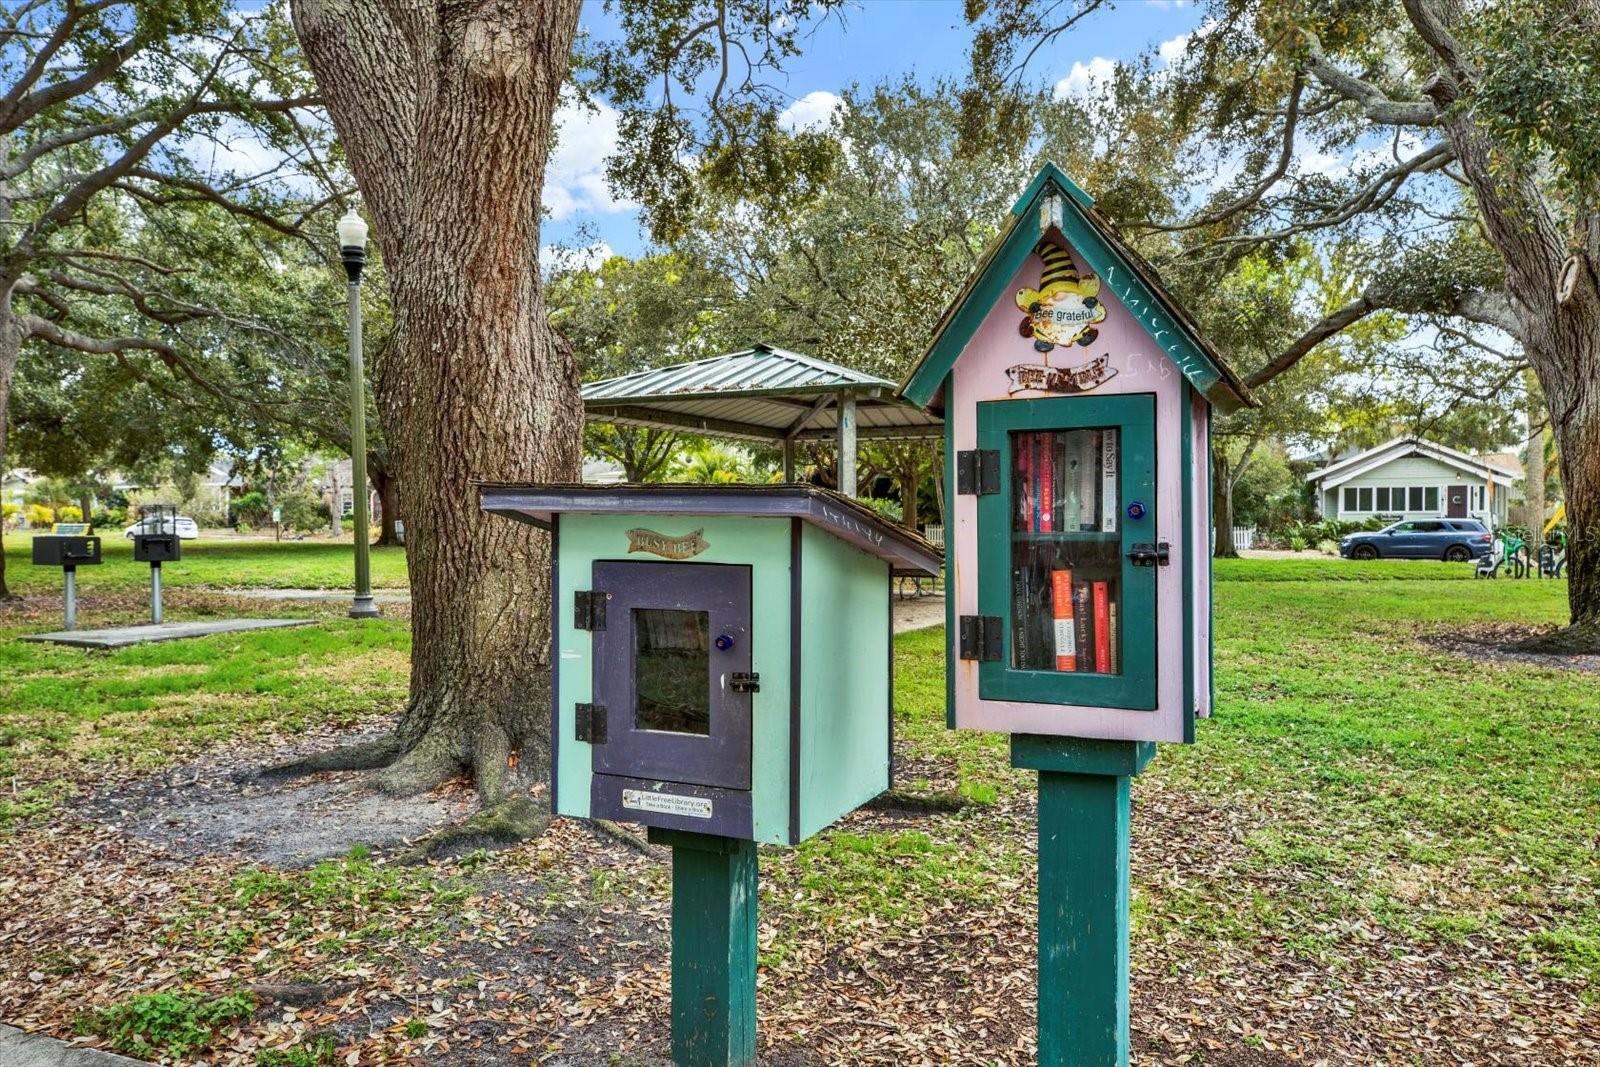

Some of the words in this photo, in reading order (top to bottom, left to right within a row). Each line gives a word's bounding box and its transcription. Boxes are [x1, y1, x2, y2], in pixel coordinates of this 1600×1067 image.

[1035, 310, 1054, 319] Bee
[1056, 310, 1094, 322] grateful
[1104, 452, 1115, 470] Say
[1106, 470, 1115, 479] It
